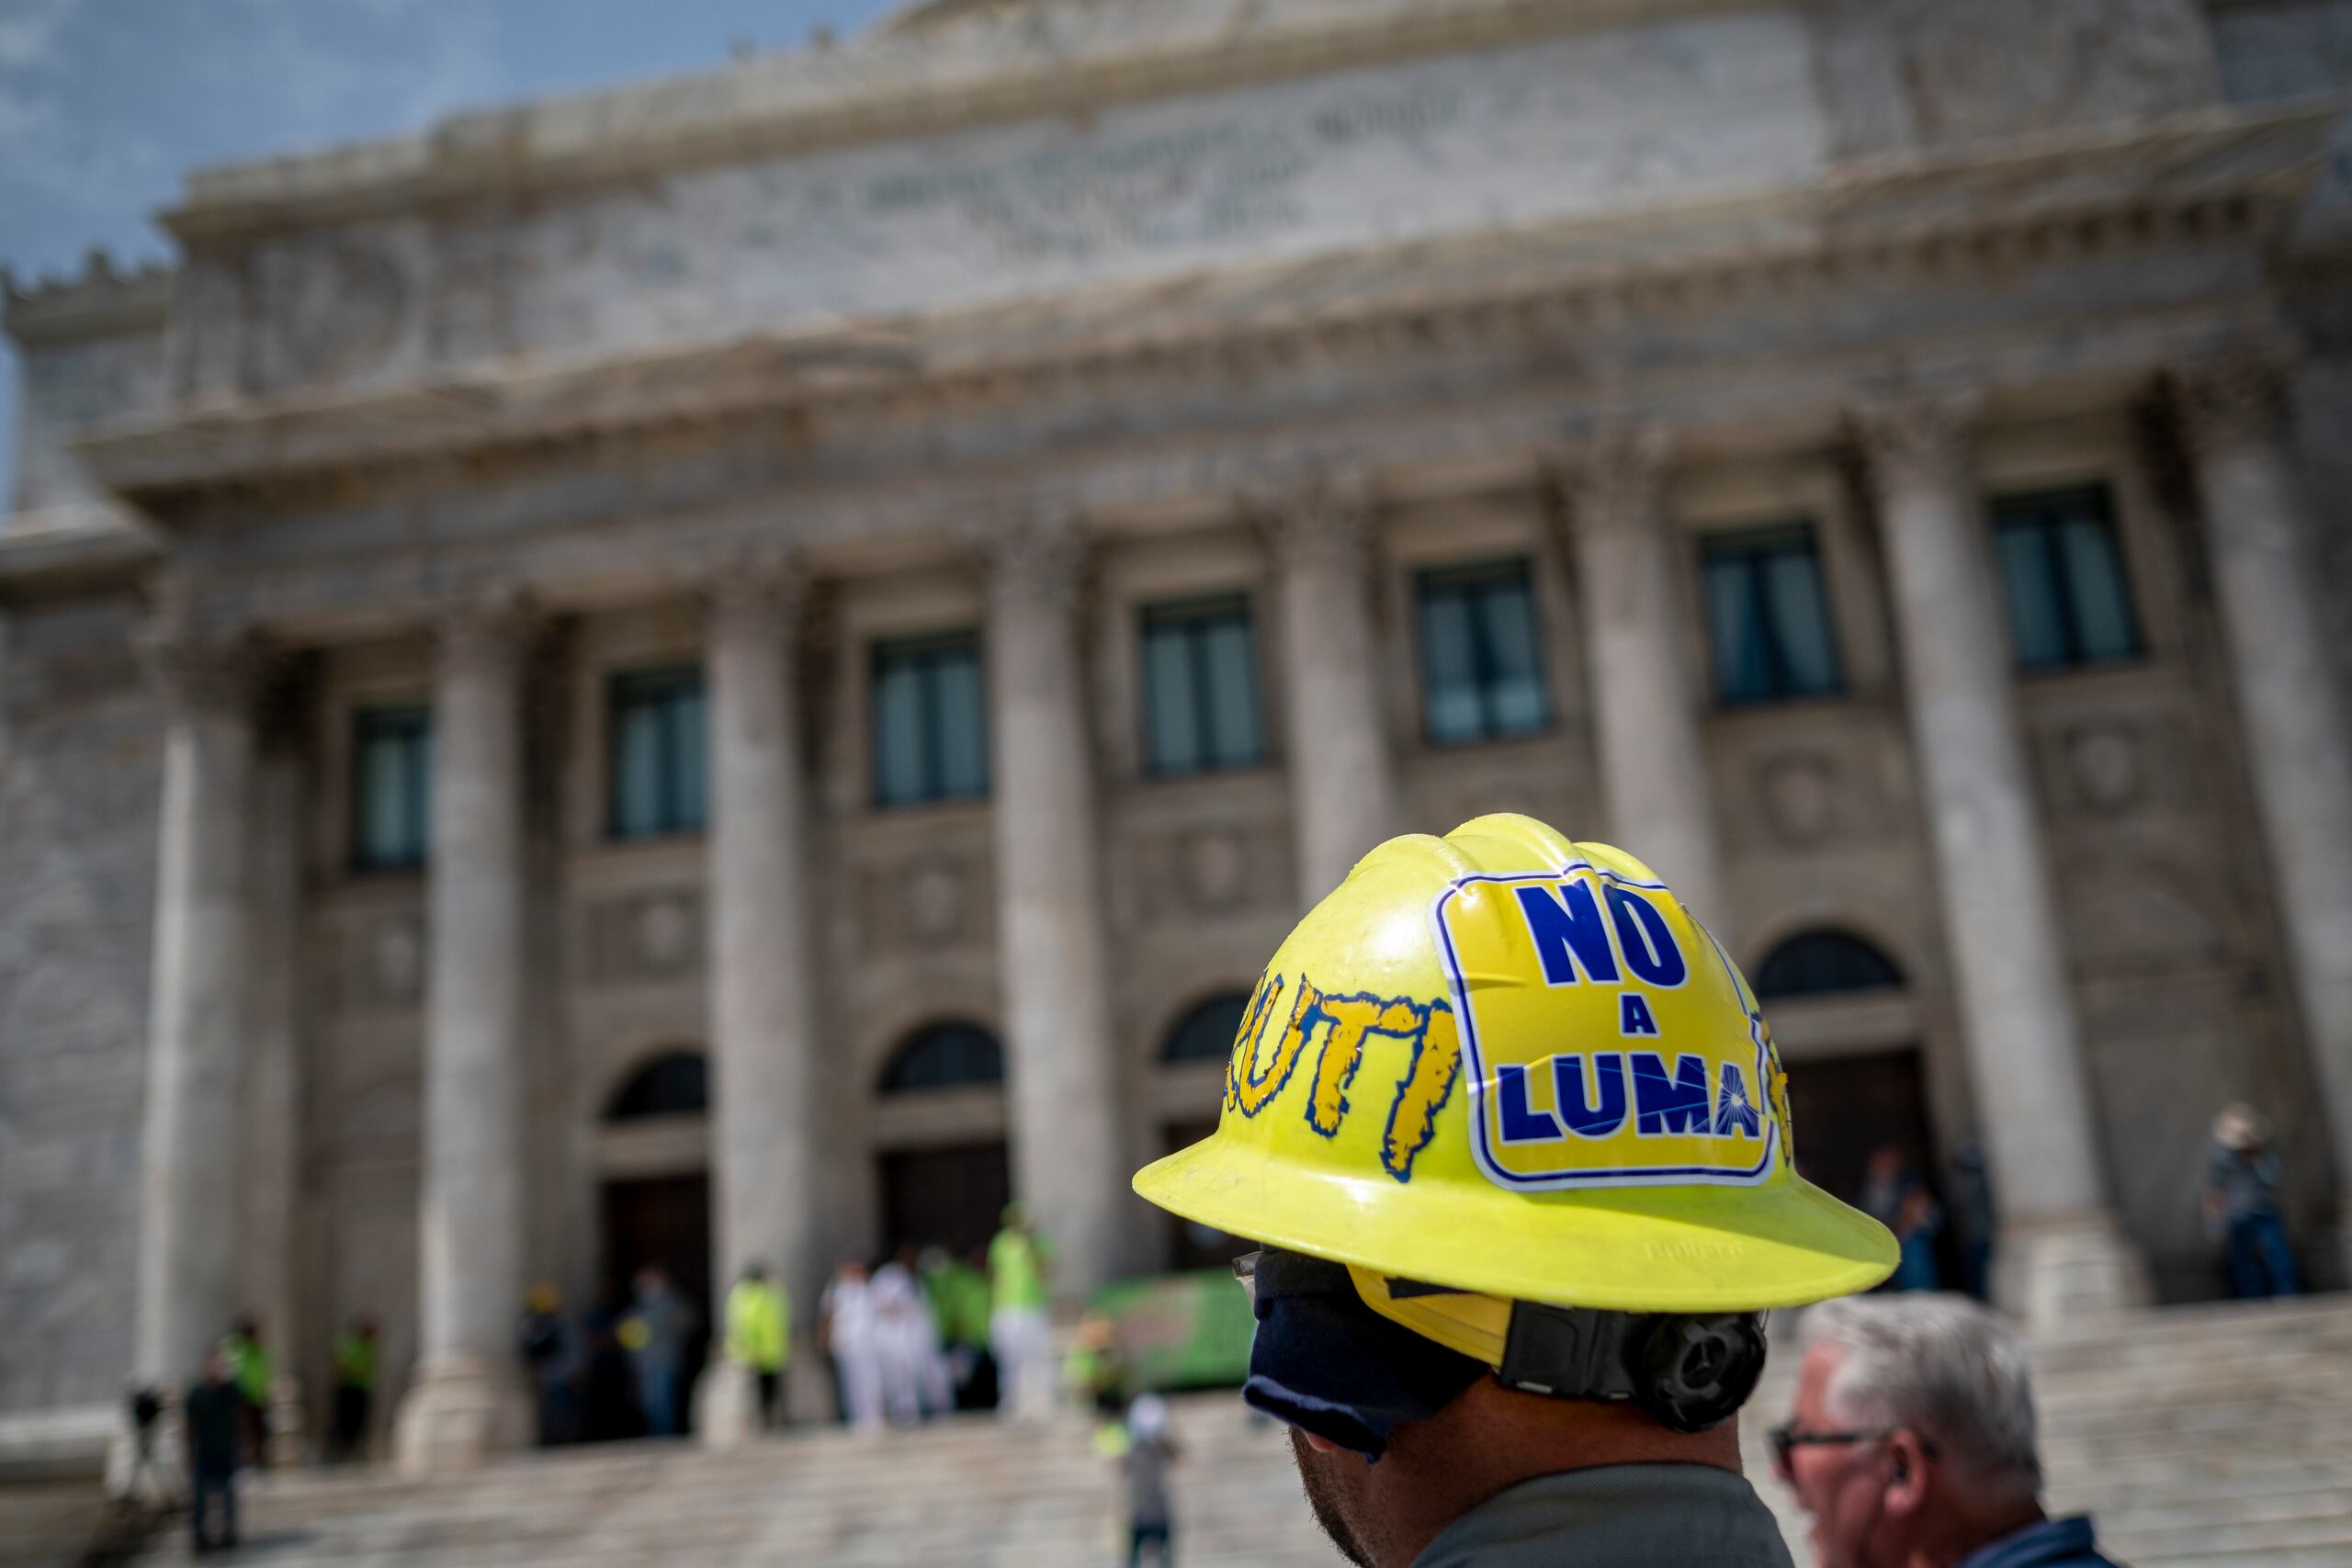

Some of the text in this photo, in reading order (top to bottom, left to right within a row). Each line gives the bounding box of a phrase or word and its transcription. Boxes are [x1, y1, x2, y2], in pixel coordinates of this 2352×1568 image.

[1514, 876, 1686, 987] NO
[1620, 994, 1658, 1034] A
[1497, 1053, 1760, 1142] LUMA
